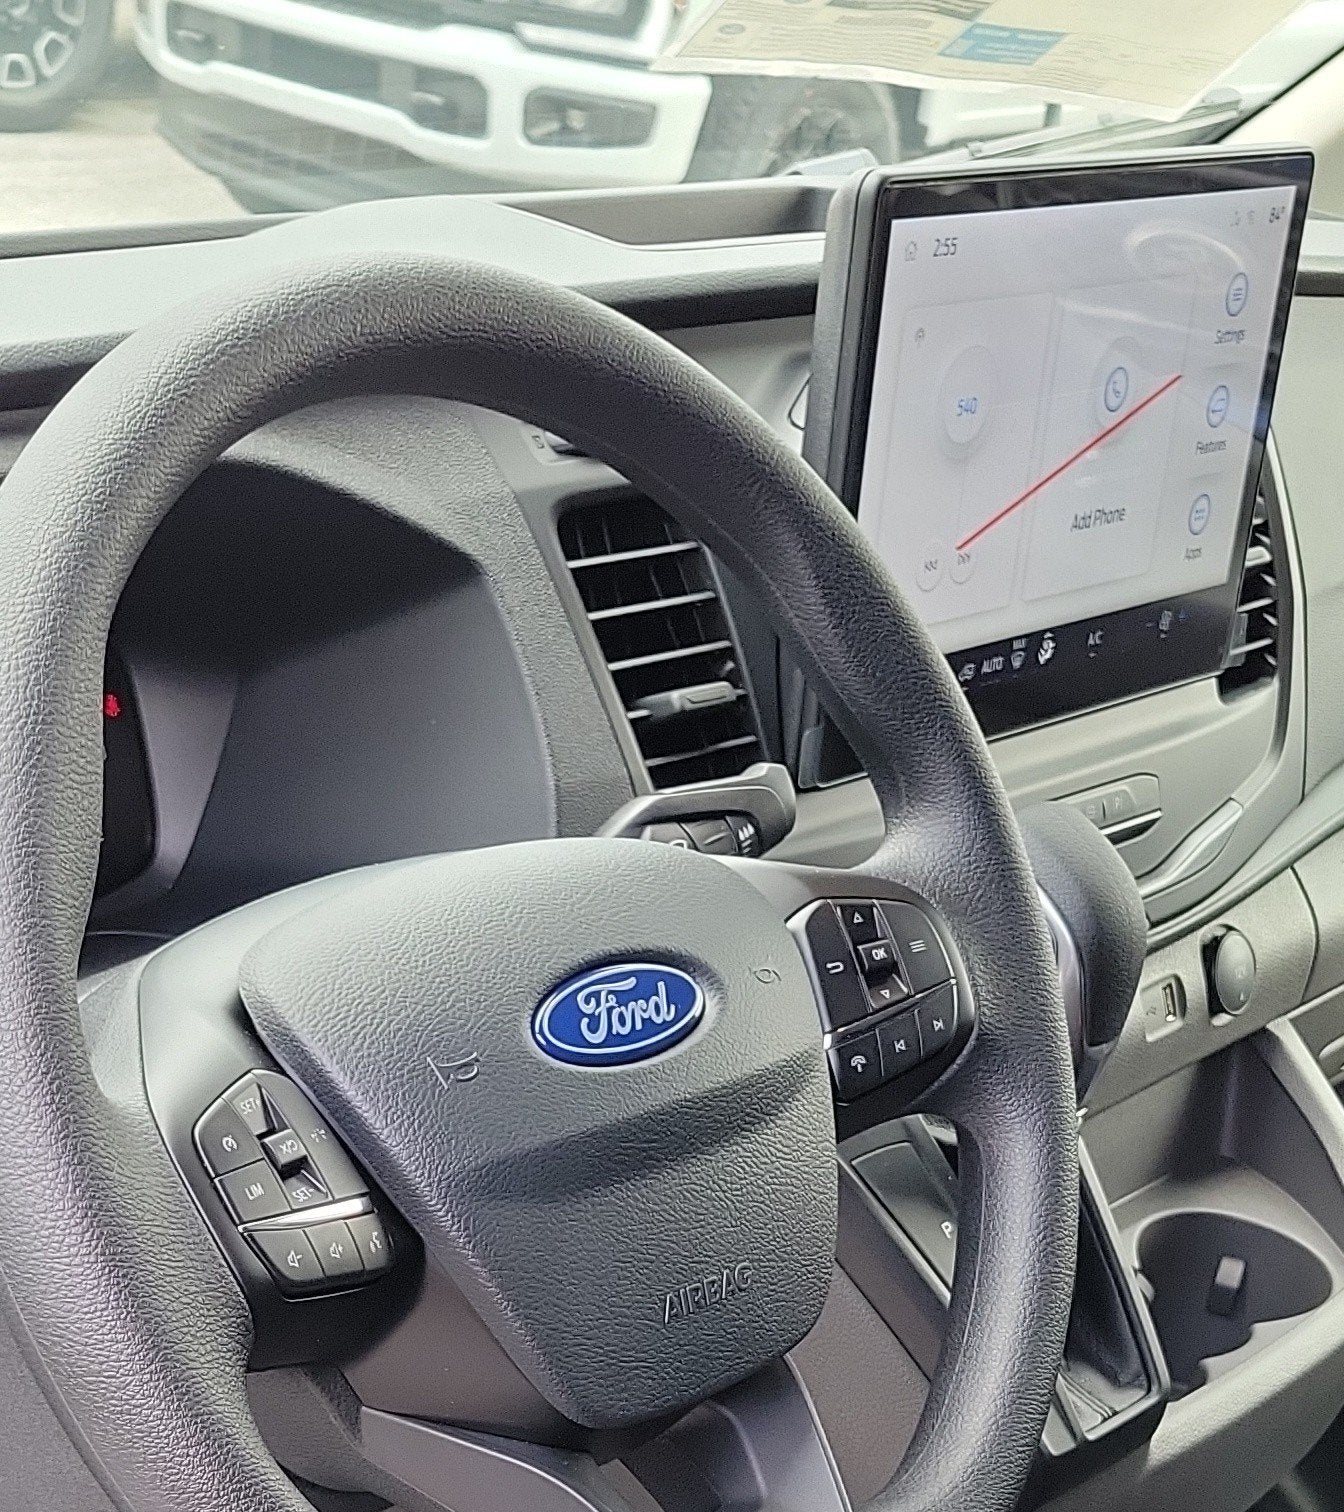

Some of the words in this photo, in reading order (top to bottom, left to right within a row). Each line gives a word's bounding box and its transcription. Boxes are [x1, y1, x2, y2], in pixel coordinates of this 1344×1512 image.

[933, 236, 959, 258] 2:55
[1070, 509, 1093, 533] Add
[1093, 506, 1126, 528] Phone
[980, 655, 1005, 675] AUTO
[871, 947, 888, 961] OK
[576, 975, 676, 1045] Ford
[244, 1182, 265, 1201] LIM
[940, 1221, 952, 1239] P
[664, 1262, 753, 1325] AIRBAG
